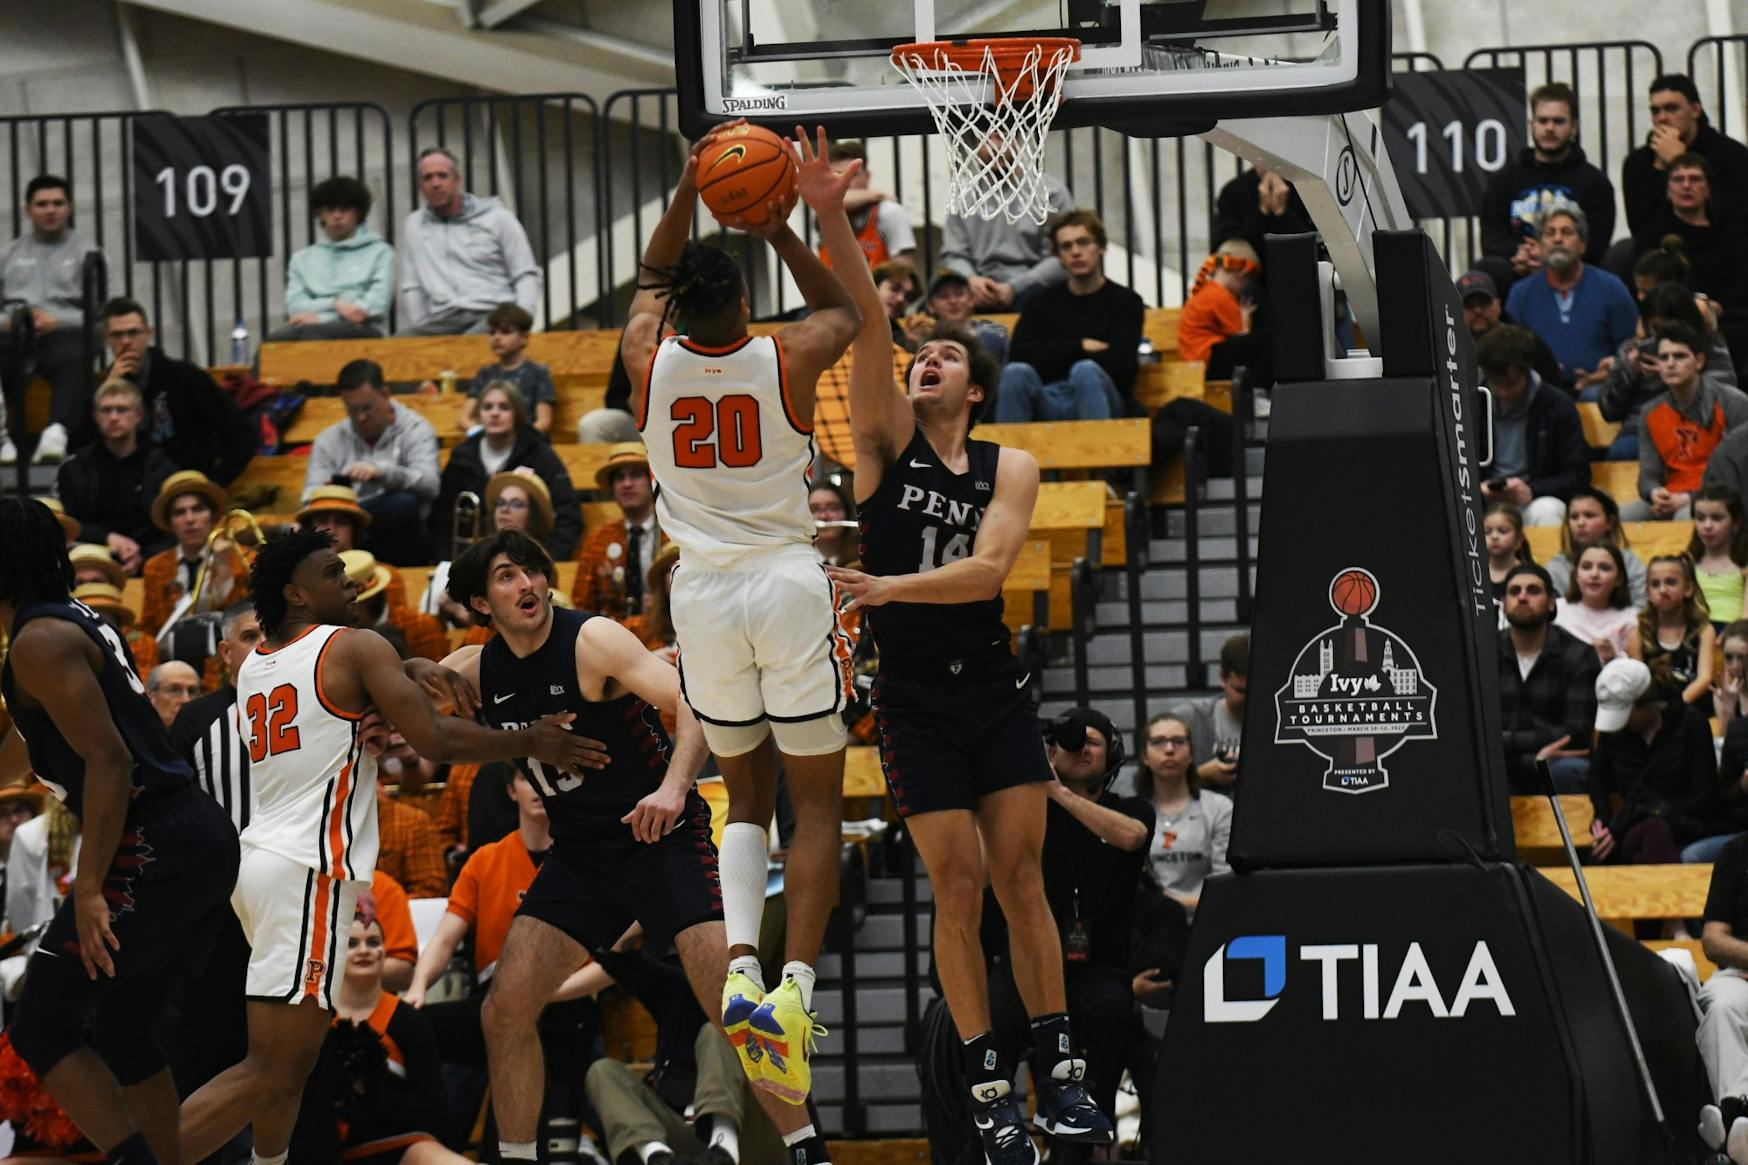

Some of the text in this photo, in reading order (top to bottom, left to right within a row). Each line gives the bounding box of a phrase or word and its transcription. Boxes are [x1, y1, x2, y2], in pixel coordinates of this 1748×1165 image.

[722, 96, 785, 113] SPALDING
[1407, 119, 1507, 174] 110
[156, 164, 251, 218] 109
[670, 394, 763, 469] 20
[1330, 674, 1363, 697] Ivy
[1290, 712, 1423, 725] TOURNAMENTS
[1298, 702, 1414, 714] BASKETBALL
[247, 683, 301, 763] 32
[1350, 777, 1369, 785] TIAA
[305, 958, 327, 983] P
[1300, 940, 1517, 1021] TIAA
